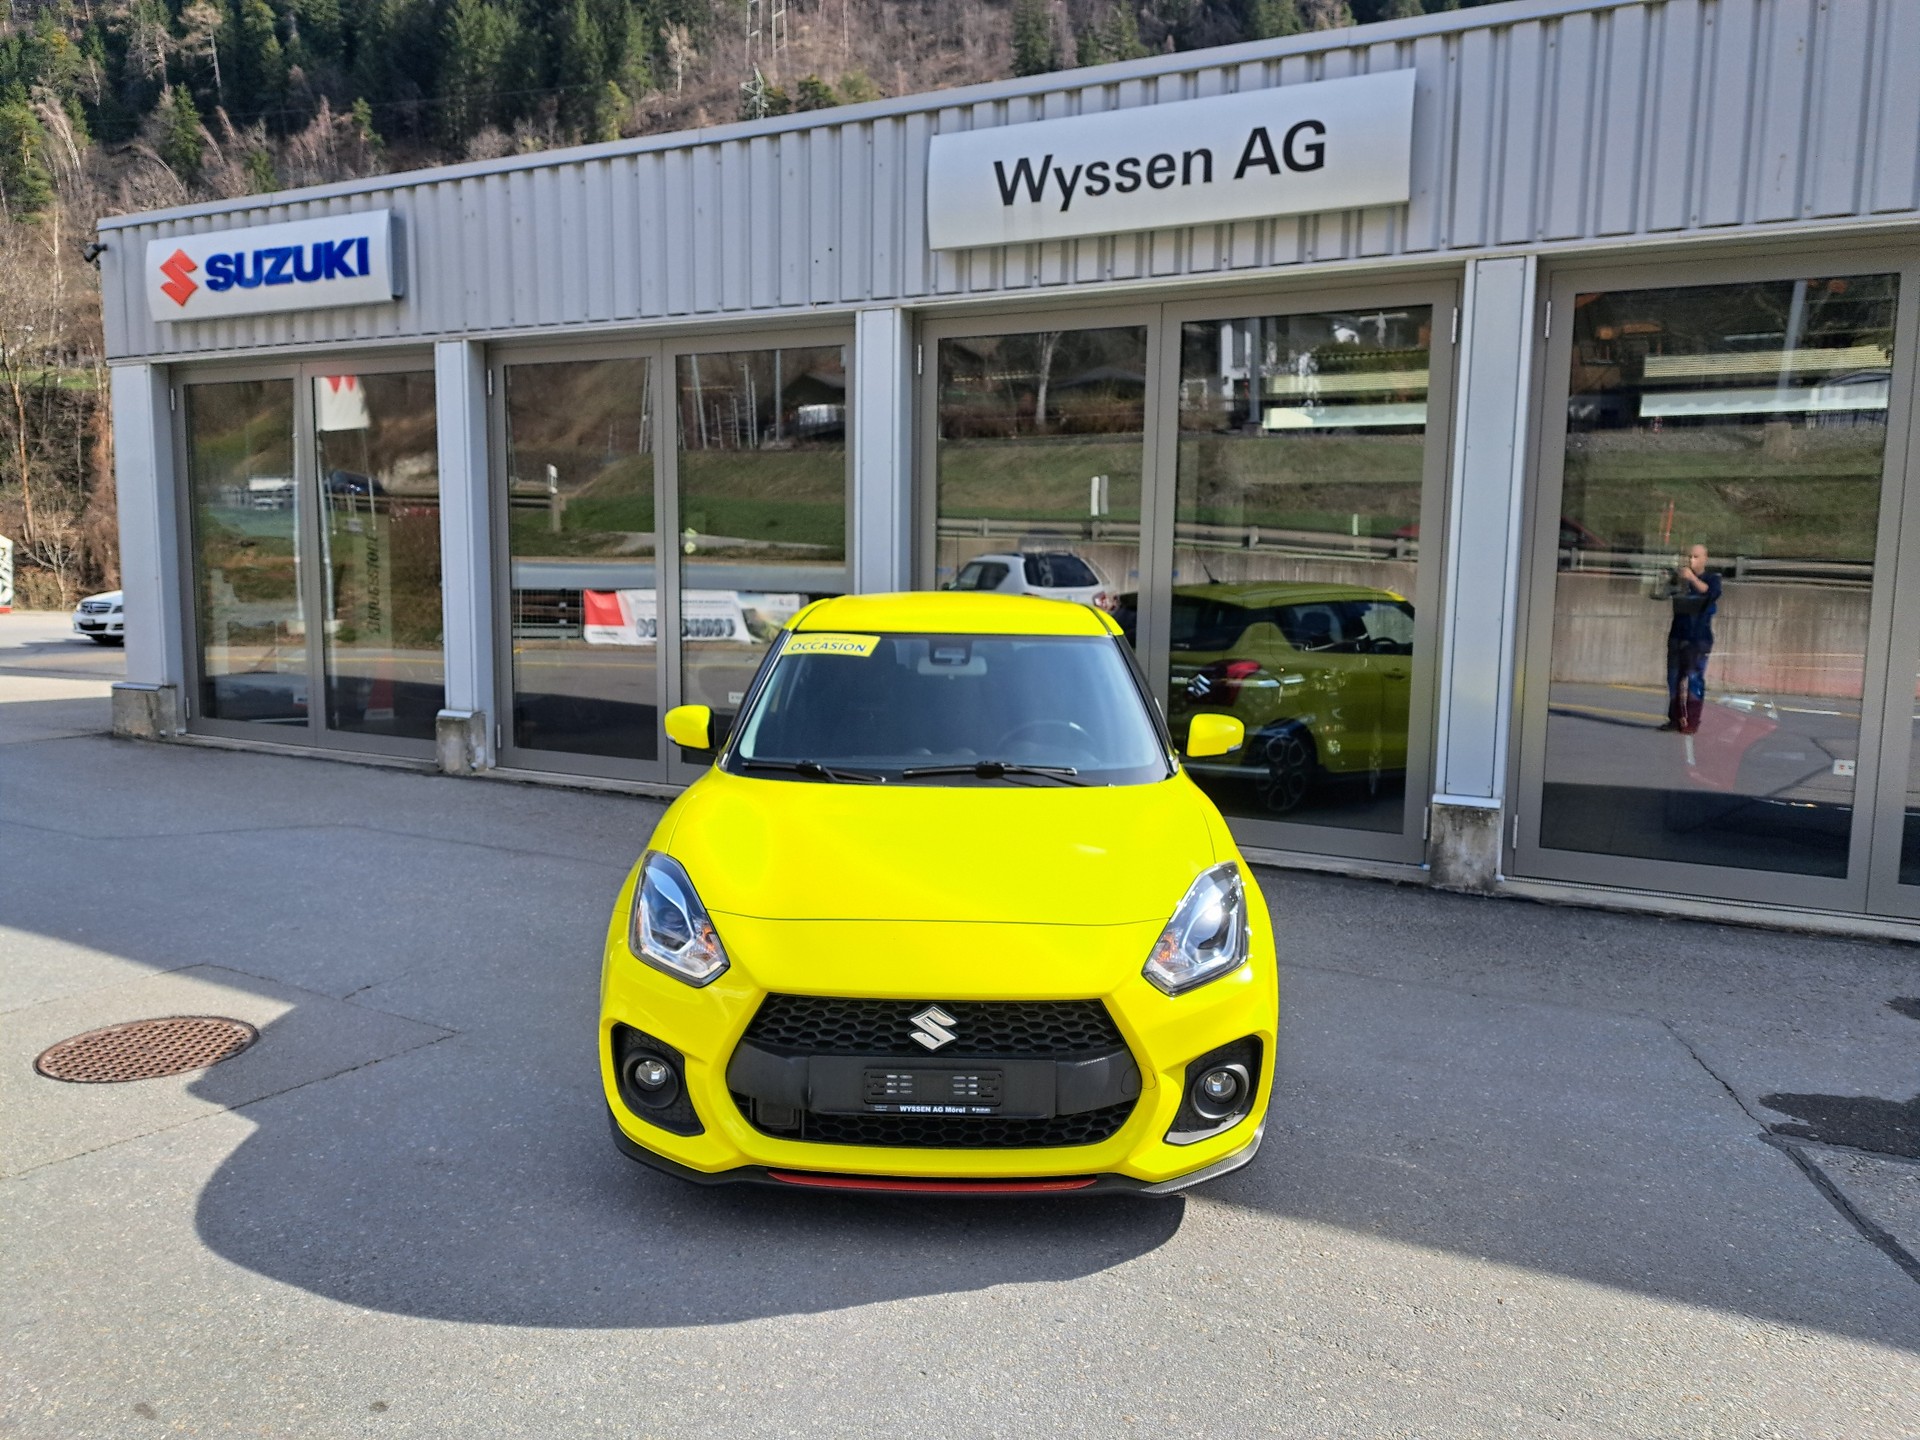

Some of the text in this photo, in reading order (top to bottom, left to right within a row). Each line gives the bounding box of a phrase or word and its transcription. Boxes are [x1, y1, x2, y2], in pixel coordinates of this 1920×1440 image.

[993, 119, 1326, 211] Wyssen AG
[205, 236, 370, 292] SUZUKI
[790, 642, 867, 653] OCCASION
[899, 1104, 931, 1113] WYSSEN
[932, 1105, 944, 1113] AG
